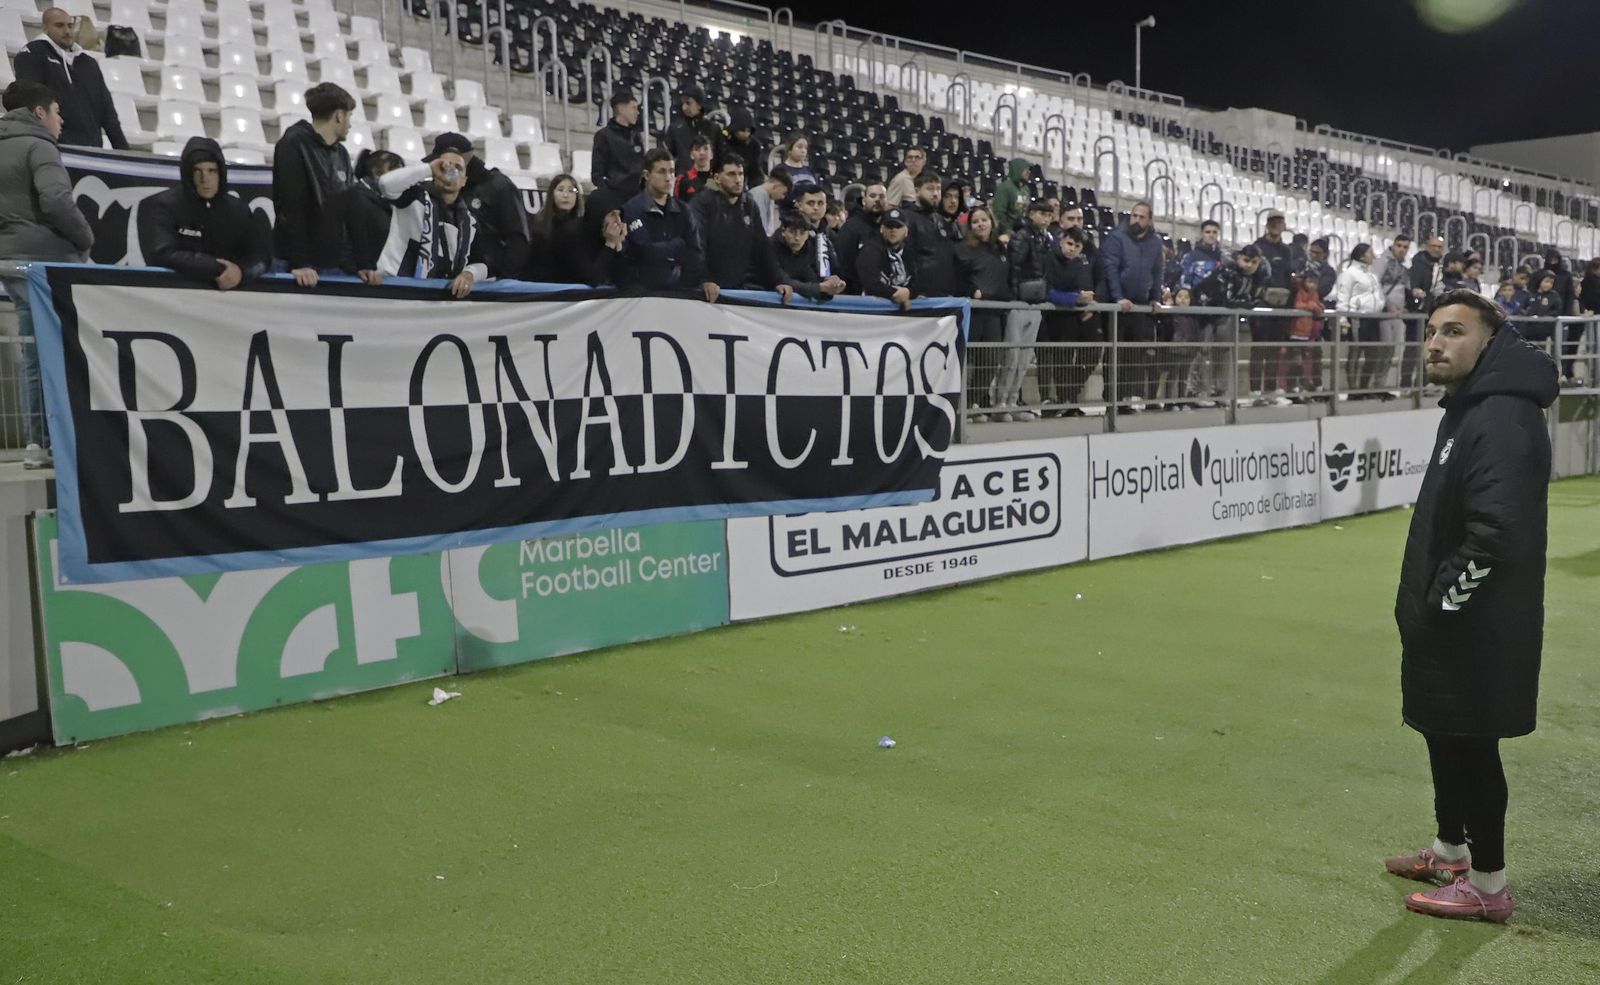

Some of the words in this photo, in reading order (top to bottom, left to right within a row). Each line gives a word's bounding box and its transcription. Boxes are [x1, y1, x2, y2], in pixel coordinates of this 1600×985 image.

[102, 329, 956, 513] BALONADICTOS
[1092, 453, 1185, 504] Hospital
[1211, 441, 1316, 497] quirónsalud
[787, 528, 831, 557] EL
[842, 498, 1050, 550] MALAGUEÑO
[1212, 501, 1255, 521] Campo
[1257, 496, 1271, 514] de
[1273, 490, 1317, 512] Gibraltar
[519, 527, 640, 567] Marbella
[883, 562, 934, 580] DESDE
[941, 554, 978, 570] 1946
[521, 558, 631, 599] Football
[638, 551, 721, 582] Center
